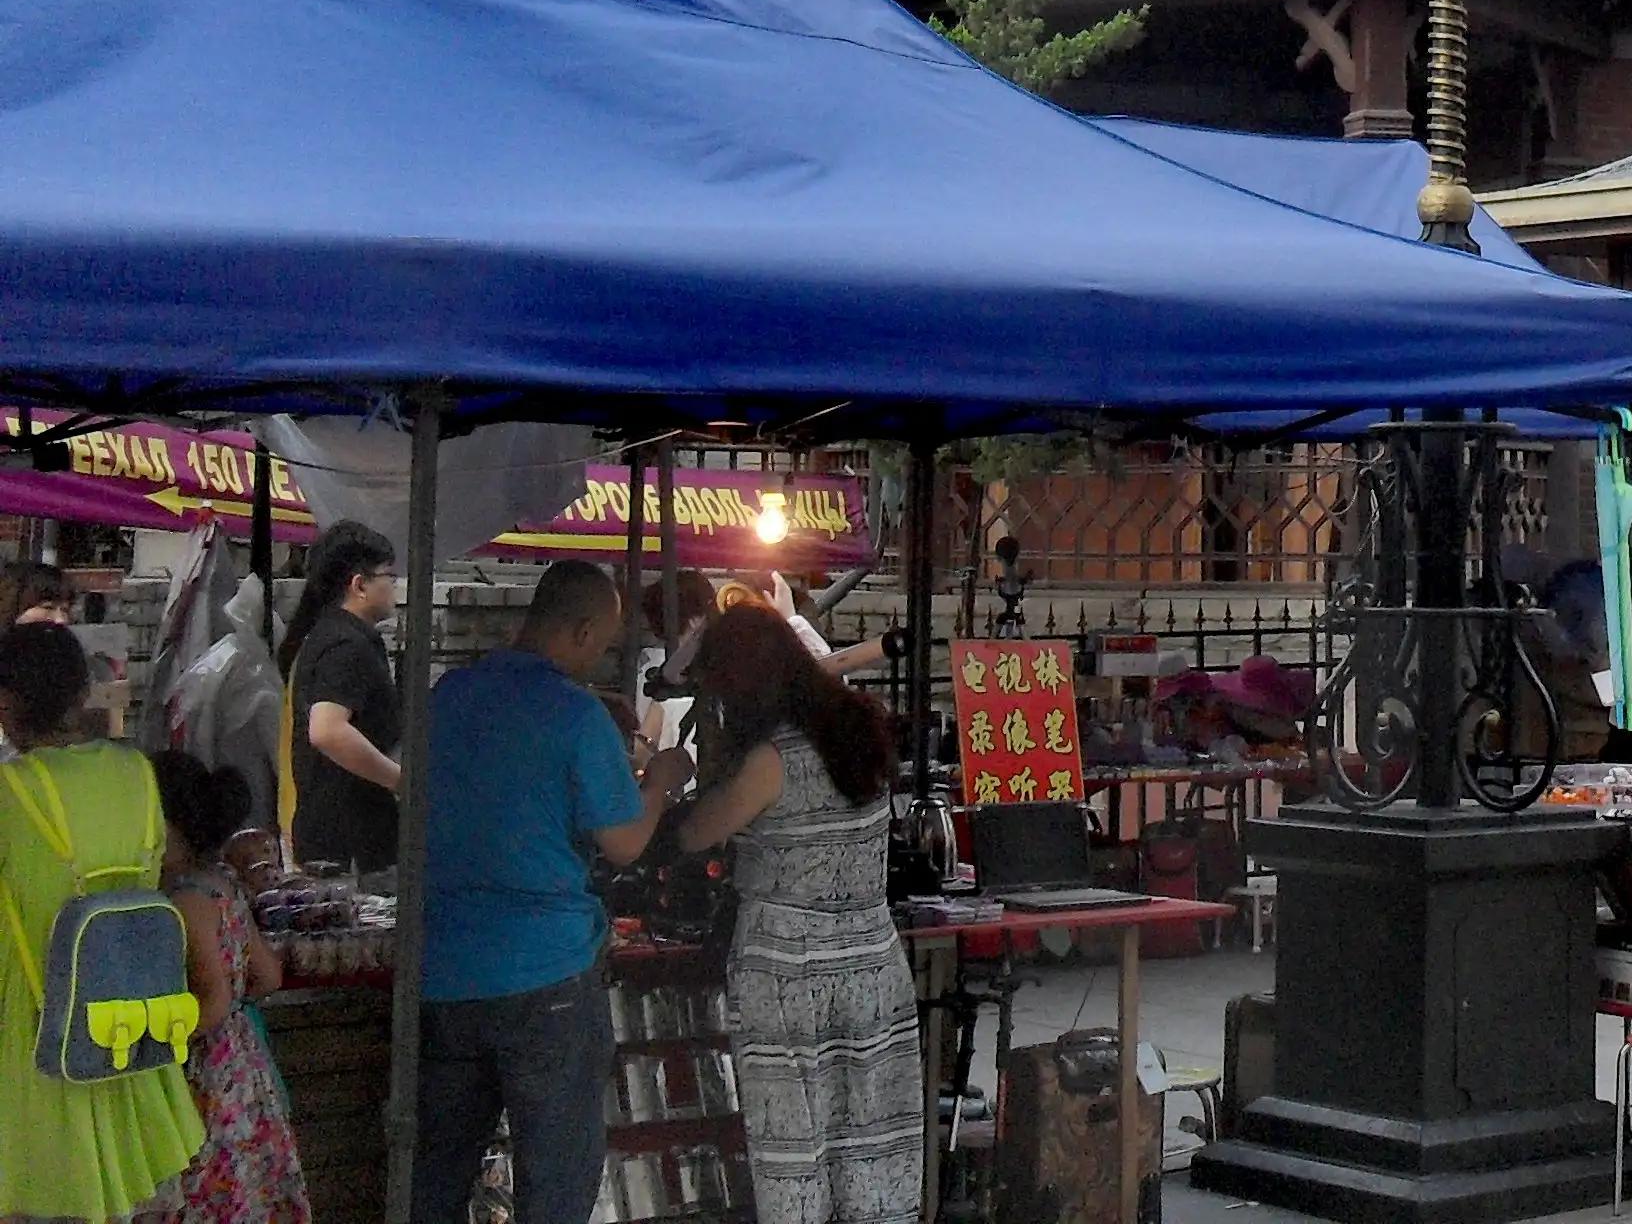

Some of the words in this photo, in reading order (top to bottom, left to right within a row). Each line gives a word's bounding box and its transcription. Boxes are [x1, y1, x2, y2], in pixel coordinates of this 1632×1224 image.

[187, 440, 245, 495] 150
[961, 647, 1068, 696] 电视棒
[967, 708, 1074, 756] 录像笔
